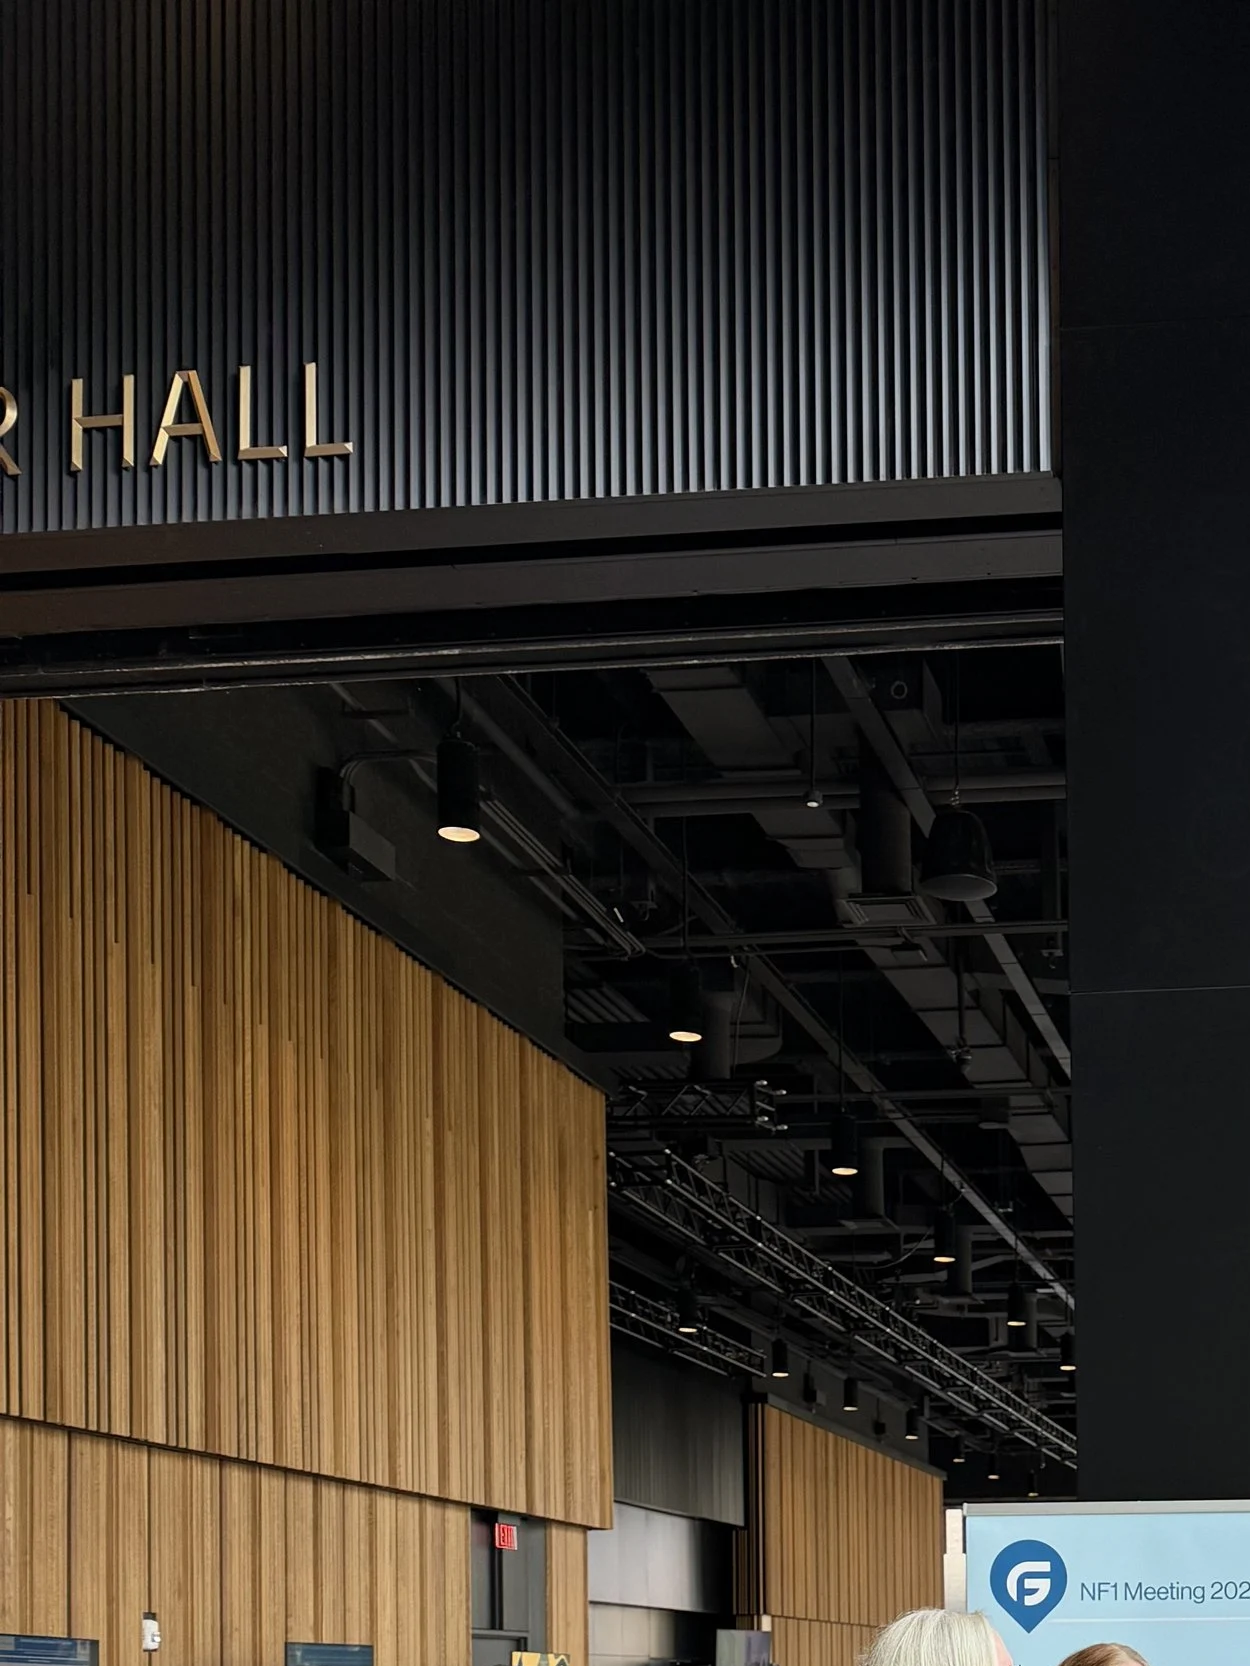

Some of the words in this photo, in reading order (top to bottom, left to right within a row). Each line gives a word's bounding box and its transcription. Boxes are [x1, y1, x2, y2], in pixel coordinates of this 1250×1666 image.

[70, 361, 354, 472] HALL
[1080, 1582, 1118, 1601] NF1
[1124, 1581, 1205, 1604] Meeting
